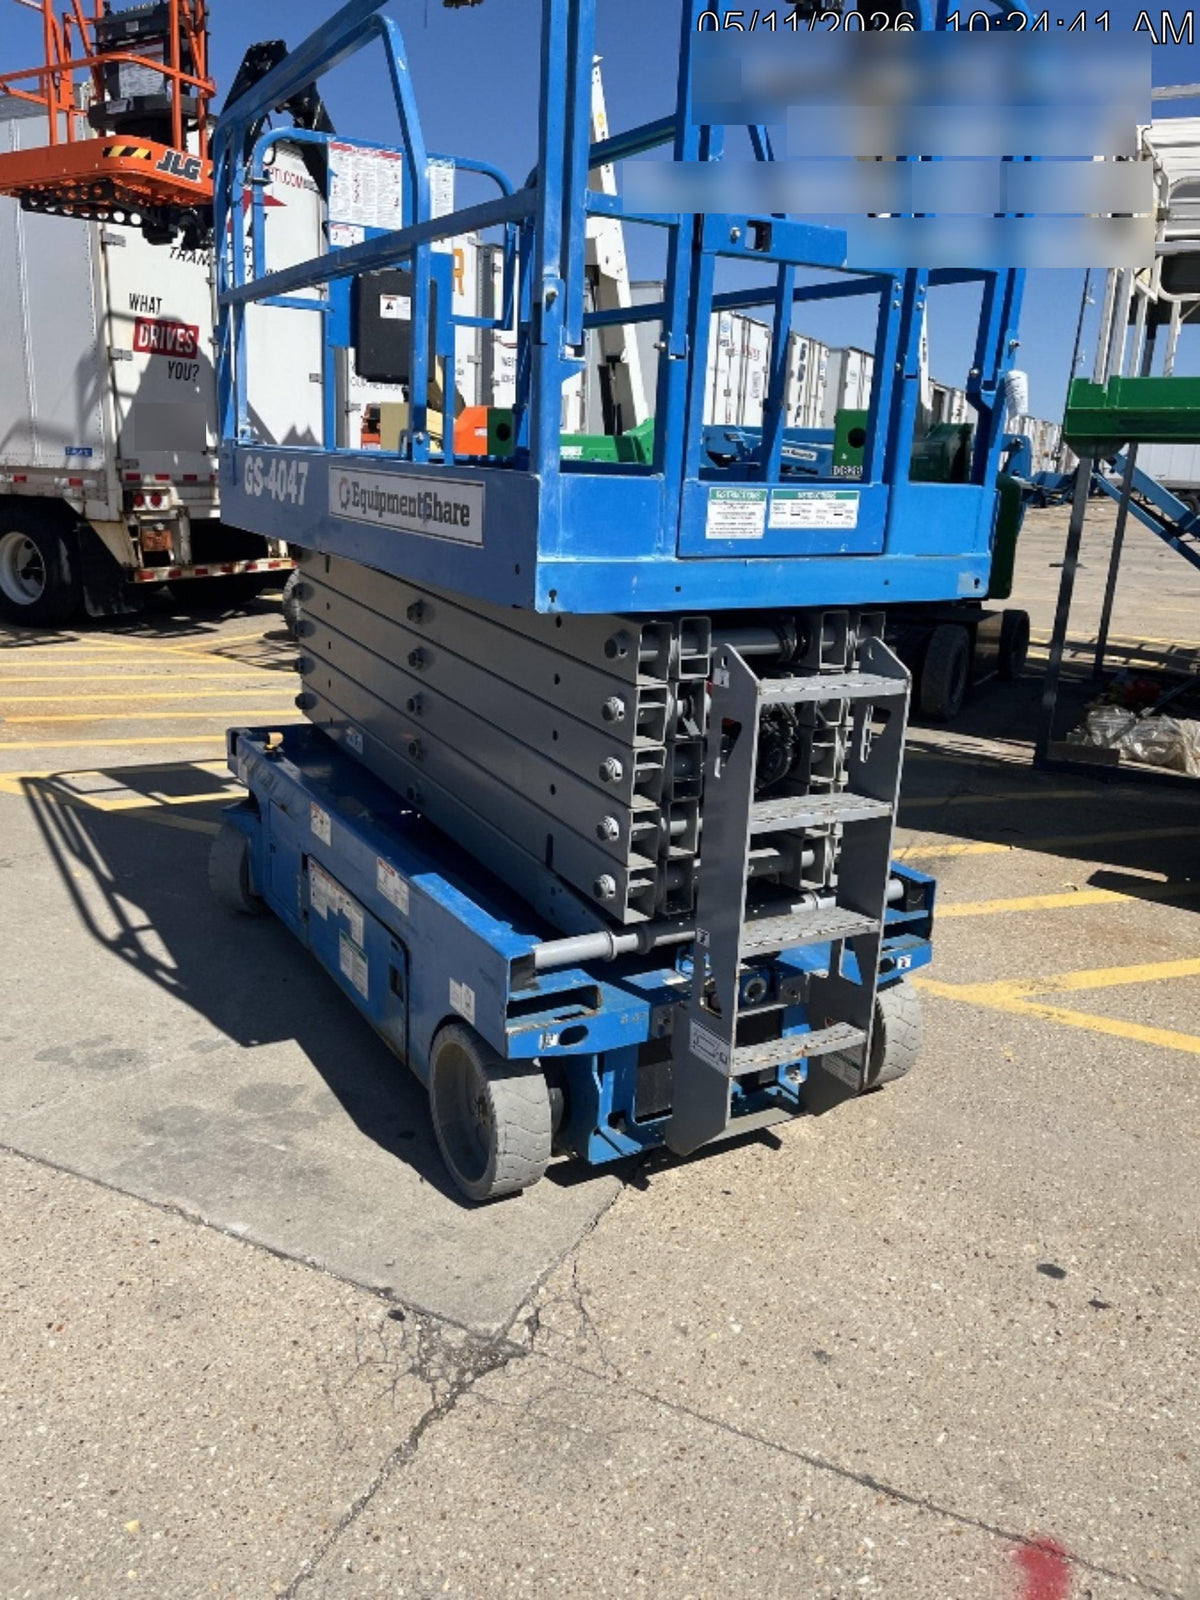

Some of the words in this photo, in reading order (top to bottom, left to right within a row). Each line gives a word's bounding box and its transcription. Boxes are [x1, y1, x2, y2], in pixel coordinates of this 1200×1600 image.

[156, 150, 201, 182] JLG
[129, 292, 162, 314] WHAT
[137, 323, 195, 353] DRIVES
[167, 361, 200, 382] YOU?
[244, 455, 309, 505] GS-4047
[351, 481, 470, 527] EquipmentShare
